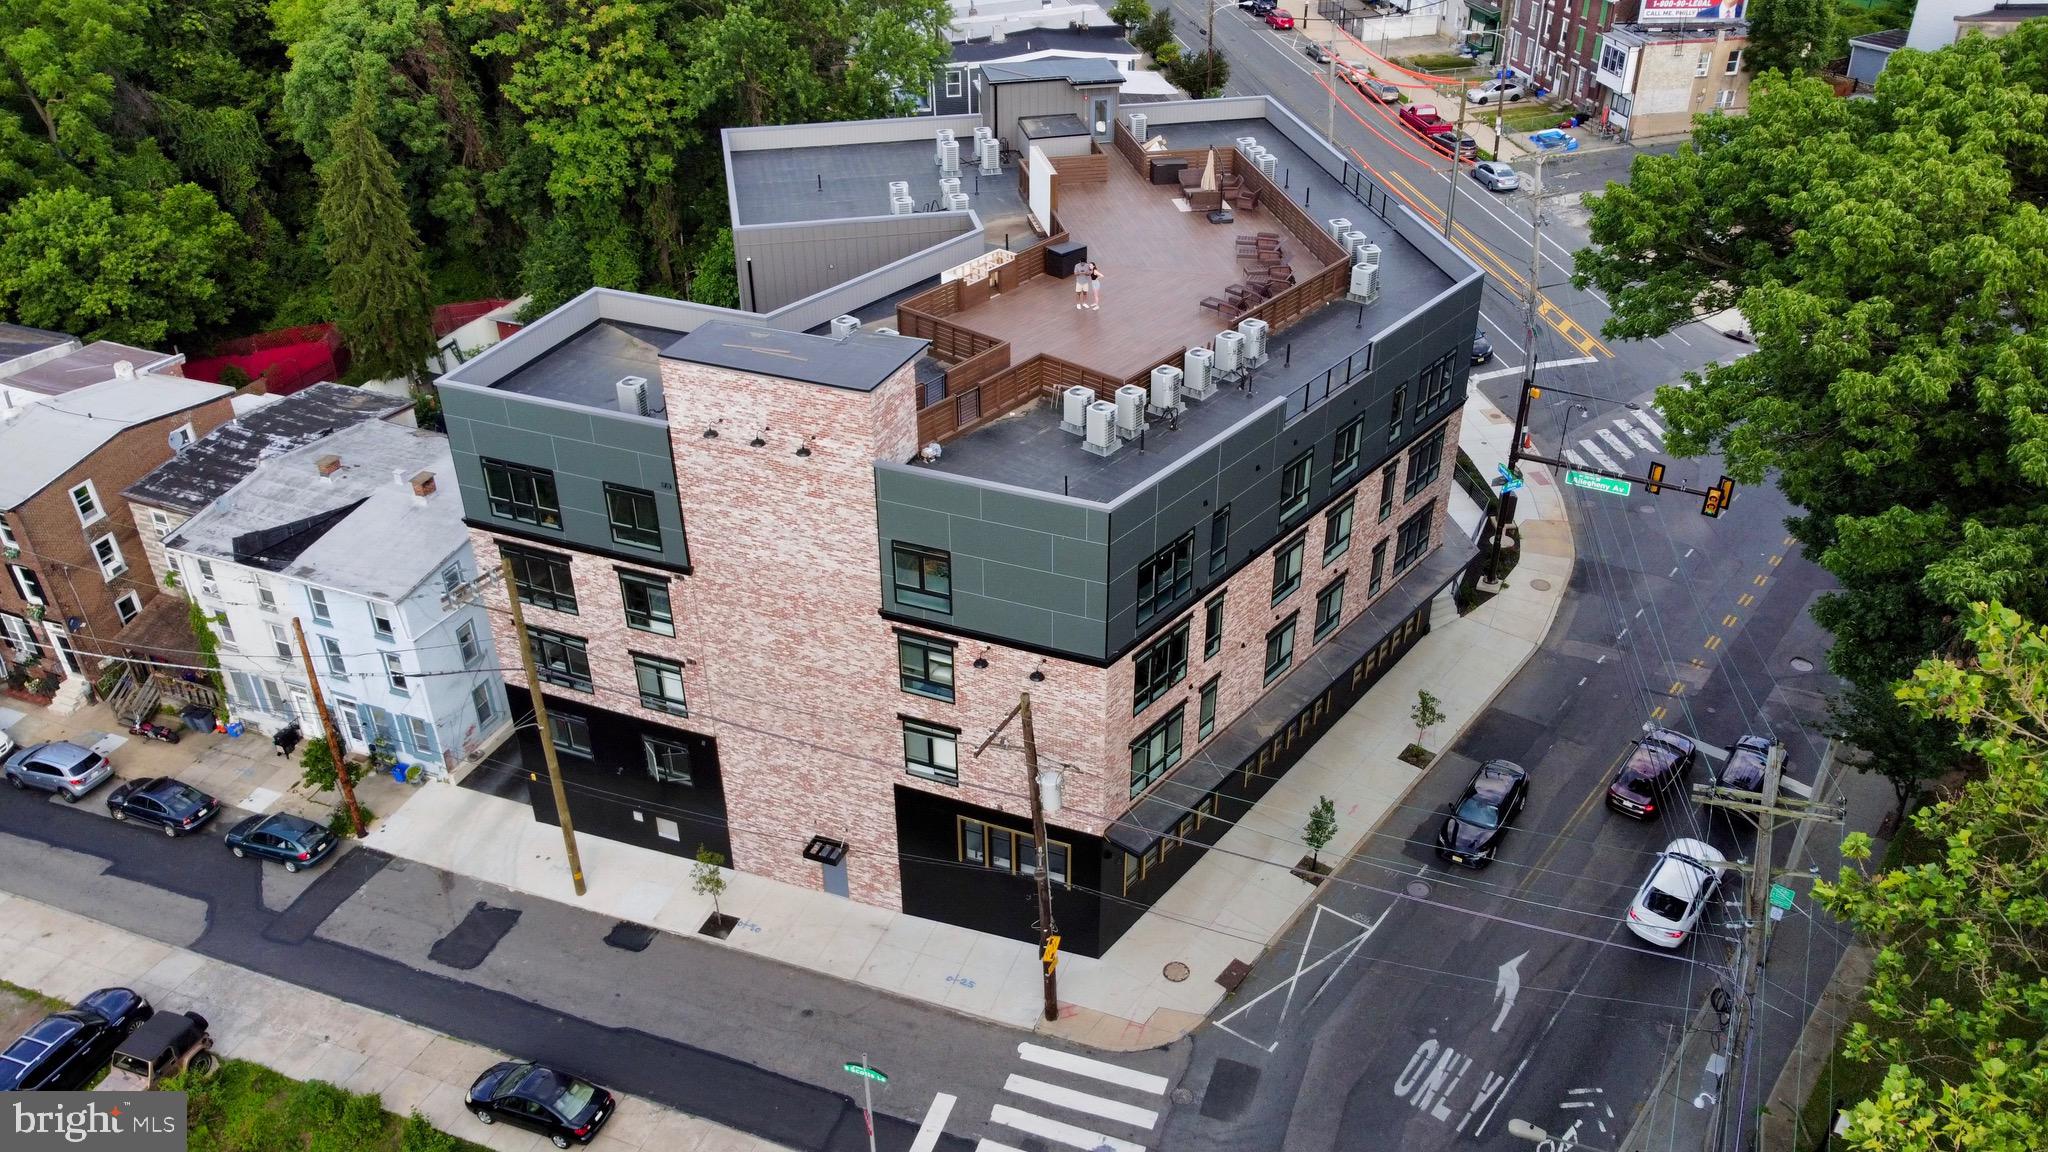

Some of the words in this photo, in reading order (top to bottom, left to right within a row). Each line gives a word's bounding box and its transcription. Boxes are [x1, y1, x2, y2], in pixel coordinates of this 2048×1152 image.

[1573, 476, 1611, 491] Allegheny
[1612, 484, 1625, 493] Av
[1394, 1039, 1505, 1132] ONLY
